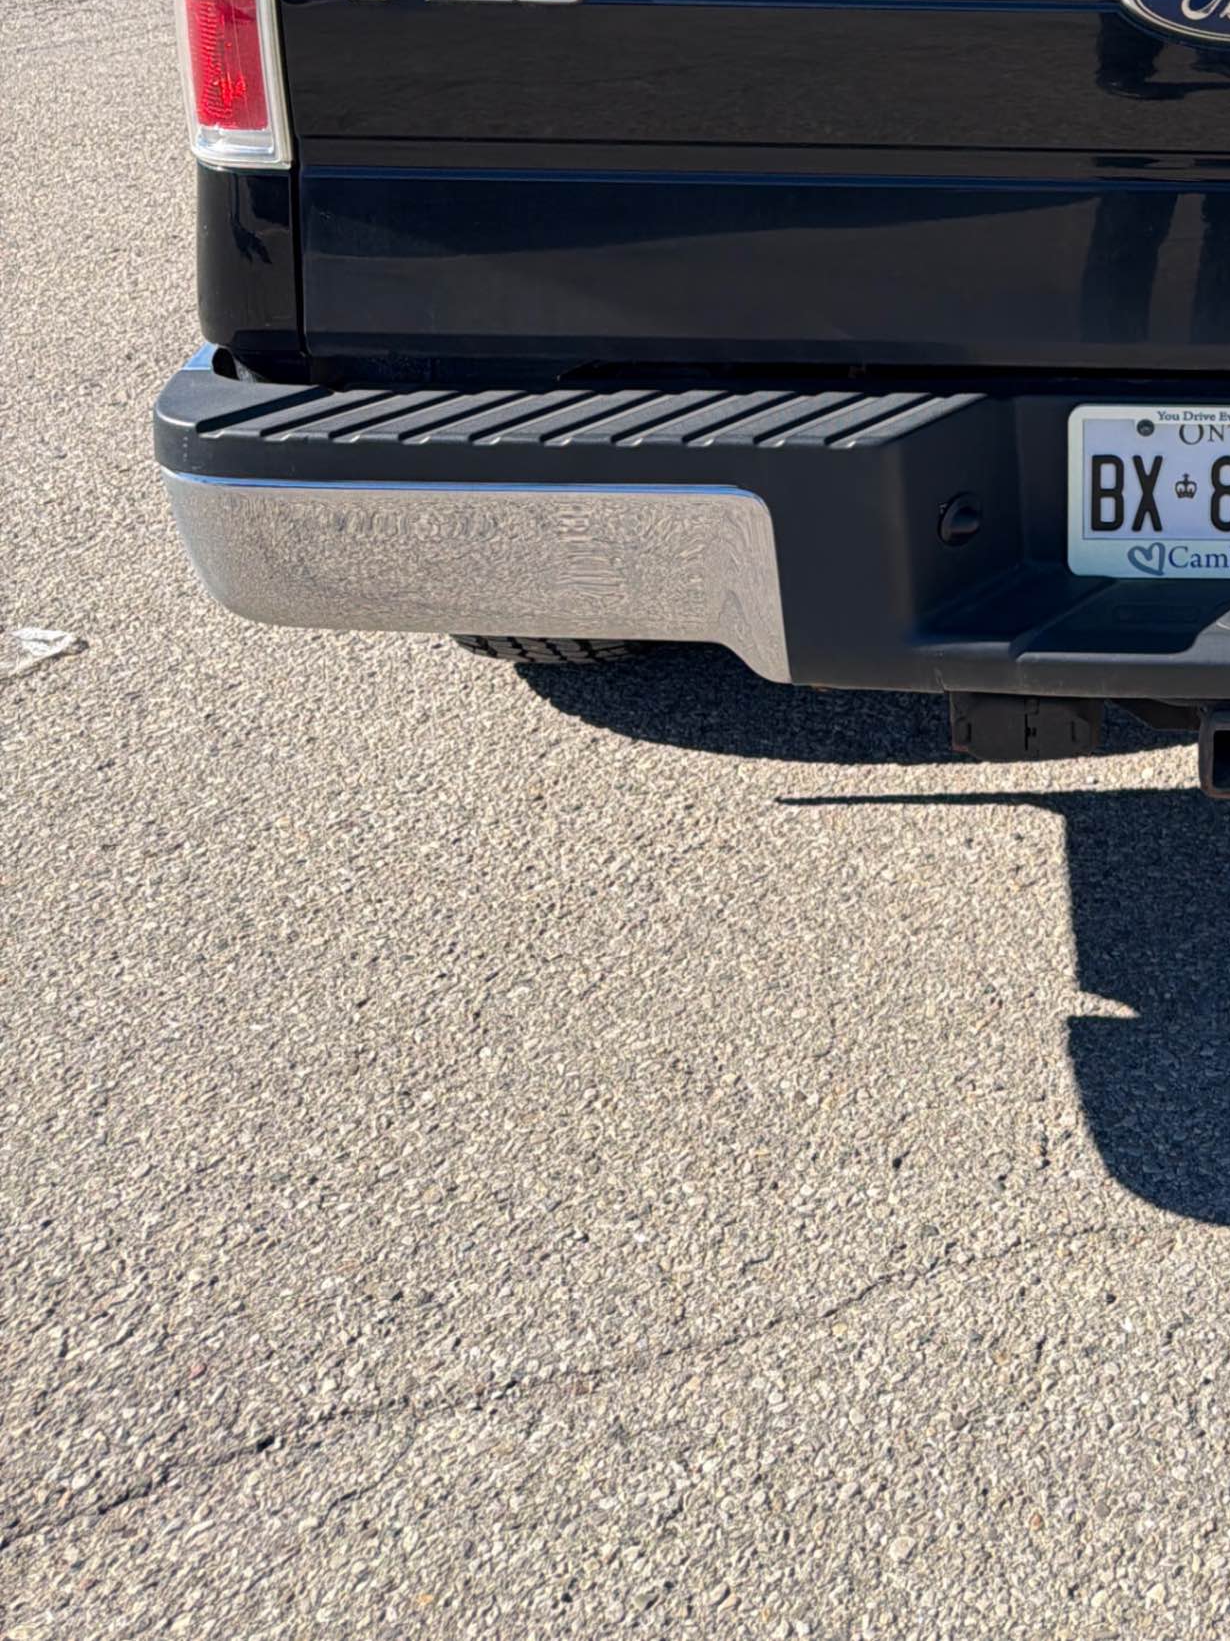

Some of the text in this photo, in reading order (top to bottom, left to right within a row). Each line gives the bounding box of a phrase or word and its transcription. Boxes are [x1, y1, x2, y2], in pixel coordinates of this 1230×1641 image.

[1157, 411, 1180, 421] You
[1183, 411, 1216, 421] Drive
[1091, 455, 1163, 532] BX
